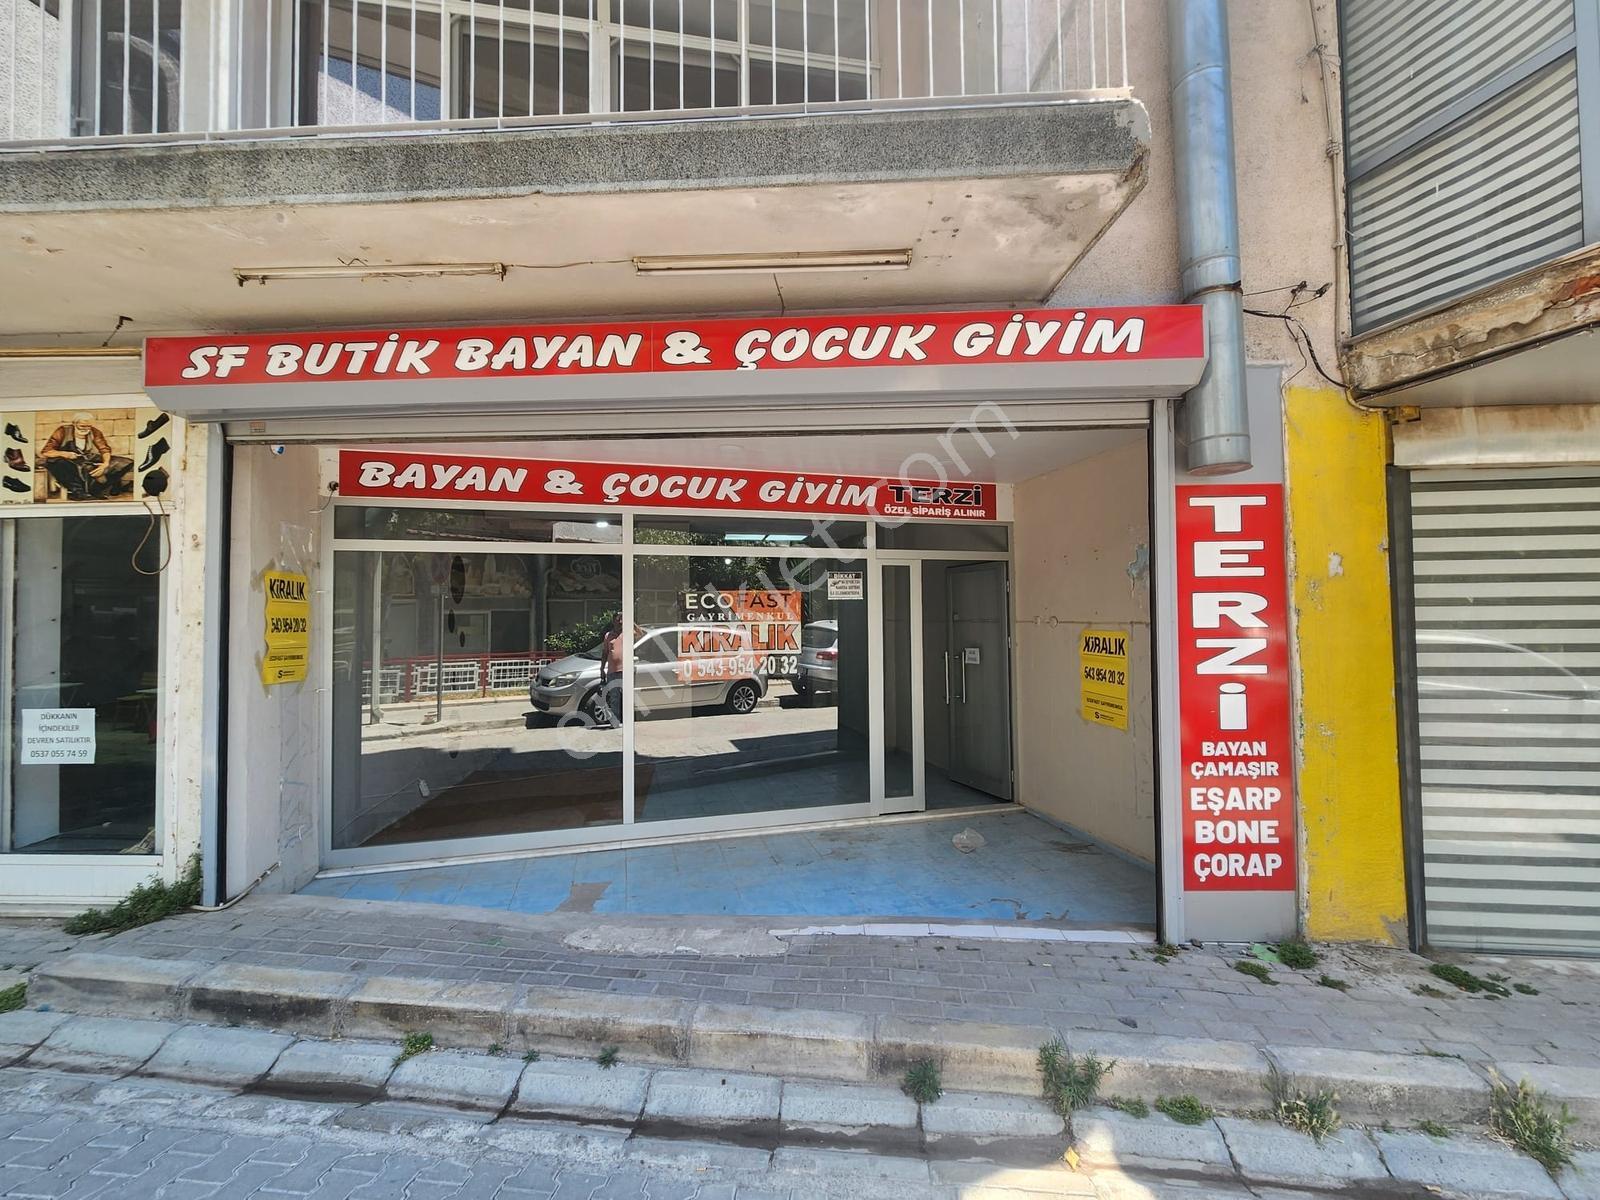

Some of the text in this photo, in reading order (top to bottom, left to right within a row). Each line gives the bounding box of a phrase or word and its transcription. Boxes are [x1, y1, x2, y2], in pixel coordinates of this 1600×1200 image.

[181, 311, 1145, 378] SF BUTİK BAYAN & ÇOCUK GİYİM
[358, 460, 983, 508] BAYAN & ÇOCUK GİYİM TERZİ
[884, 504, 986, 518] ÖZEL SİPARİŞ ALINIR
[269, 578, 307, 601] KİRALIK
[686, 611, 794, 622] GAYRİMENKUL
[1189, 496, 1269, 730] TERZİ
[1083, 636, 1126, 656] KİRALIK
[758, 656, 776, 675] 20
[780, 655, 799, 675] 32
[1084, 666, 1125, 686] 543 954 20 32
[30, 750, 49, 758] 0537
[66, 750, 76, 758] 74
[1201, 741, 1267, 757] BAYAN
[1190, 761, 1280, 780] ÇAMAŞIR
[1190, 786, 1282, 816] EŞARP
[1194, 819, 1280, 844] BONE
[1194, 852, 1282, 882] ÇORAP
